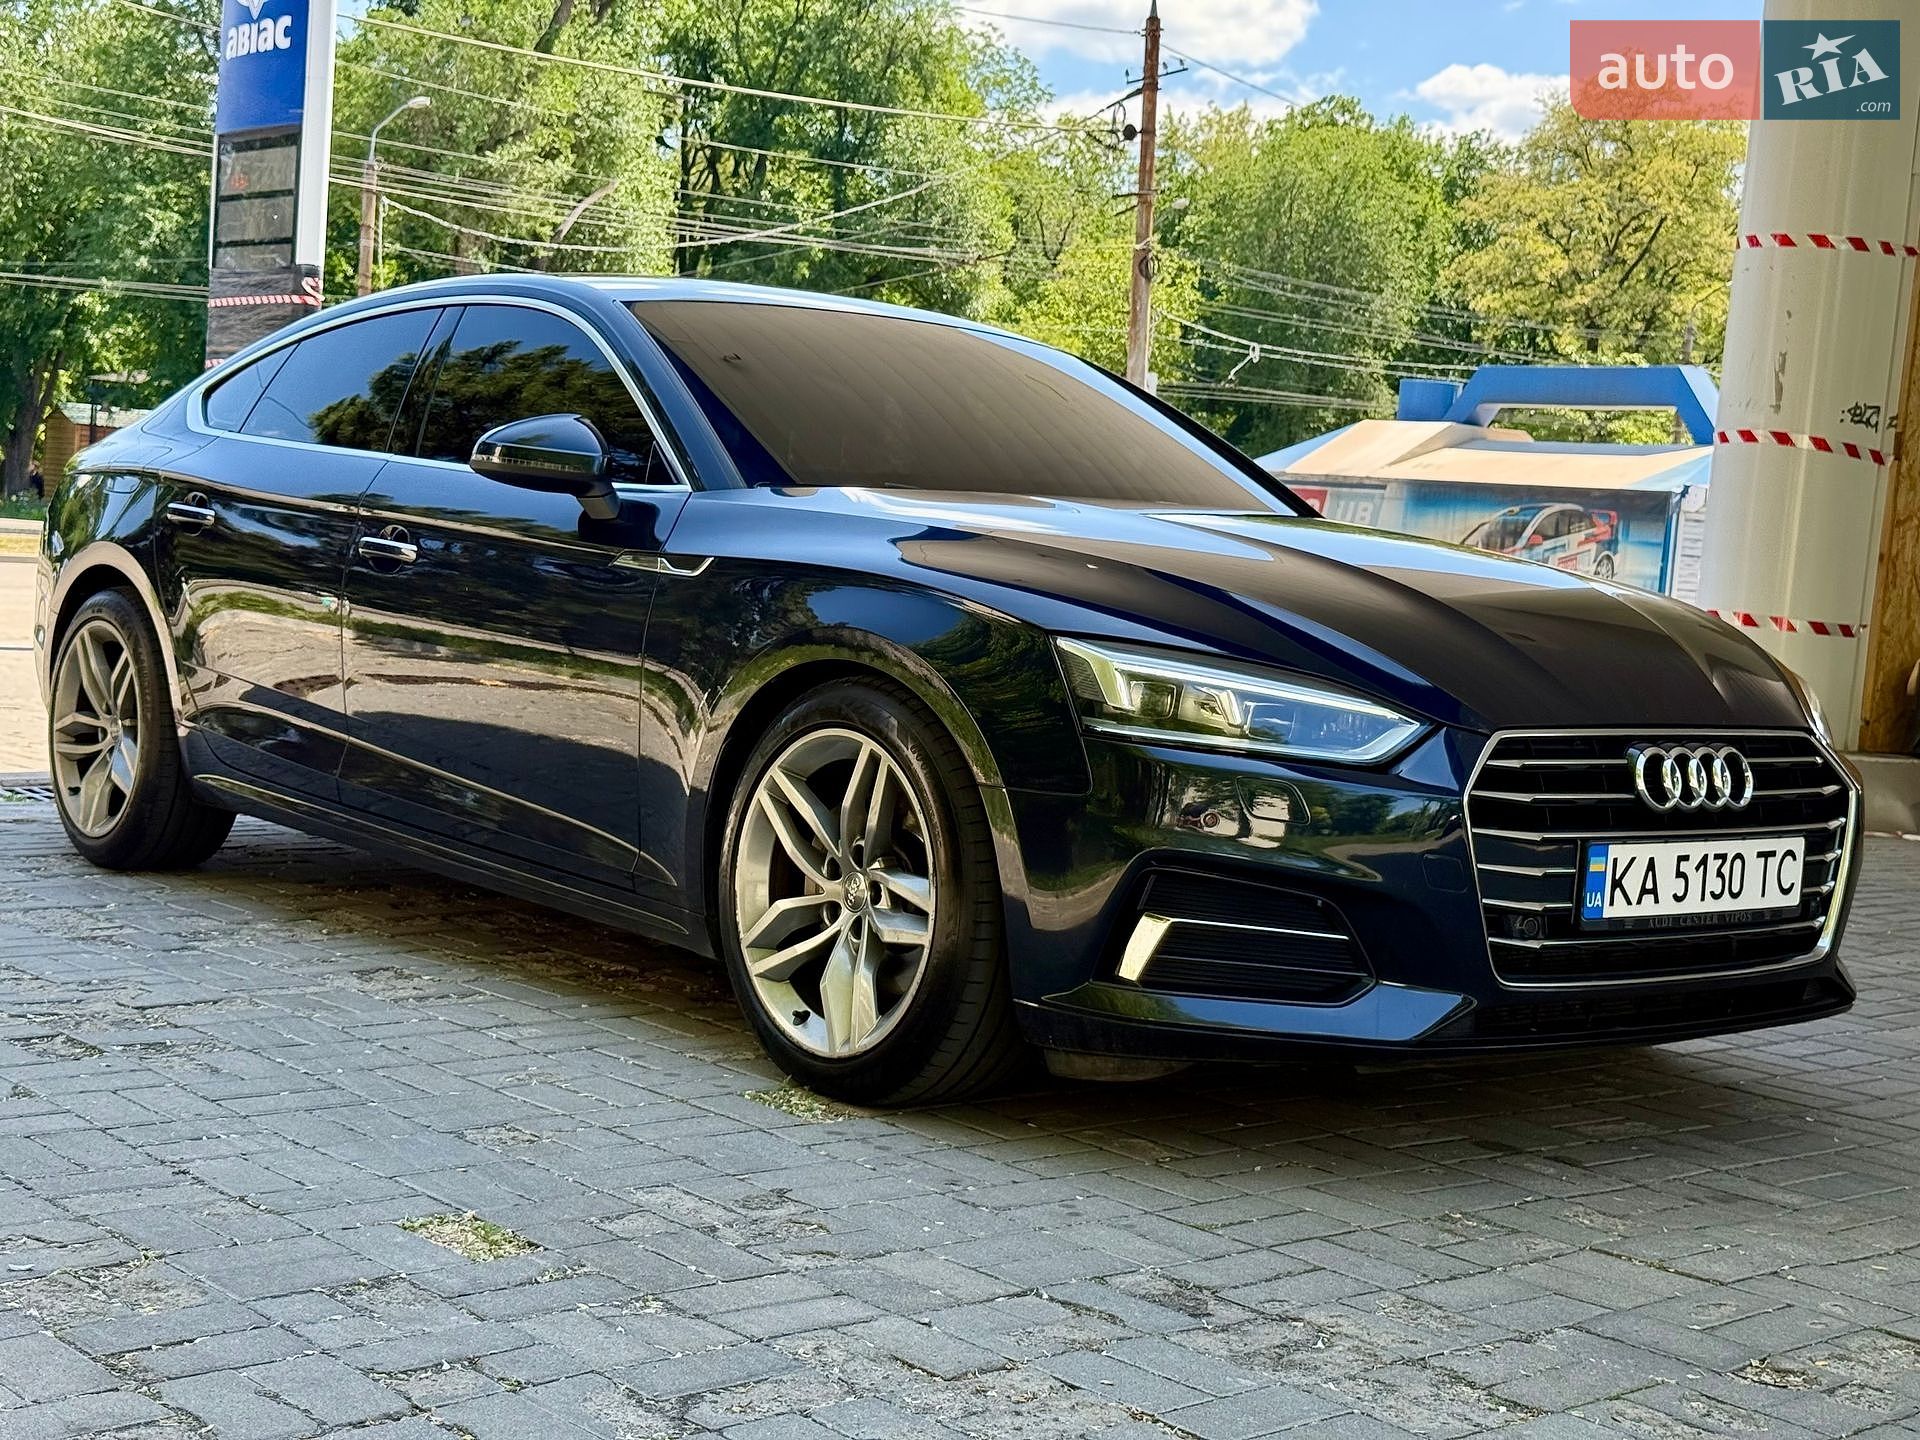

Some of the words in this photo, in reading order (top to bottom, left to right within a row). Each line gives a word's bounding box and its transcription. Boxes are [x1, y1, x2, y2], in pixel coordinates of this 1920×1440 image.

[1608, 856, 1660, 907] KA
[1672, 852, 1746, 903] 5130
[1756, 849, 1798, 898] TC
[1586, 891, 1602, 908] UA
[1648, 917, 1672, 928] AUDI
